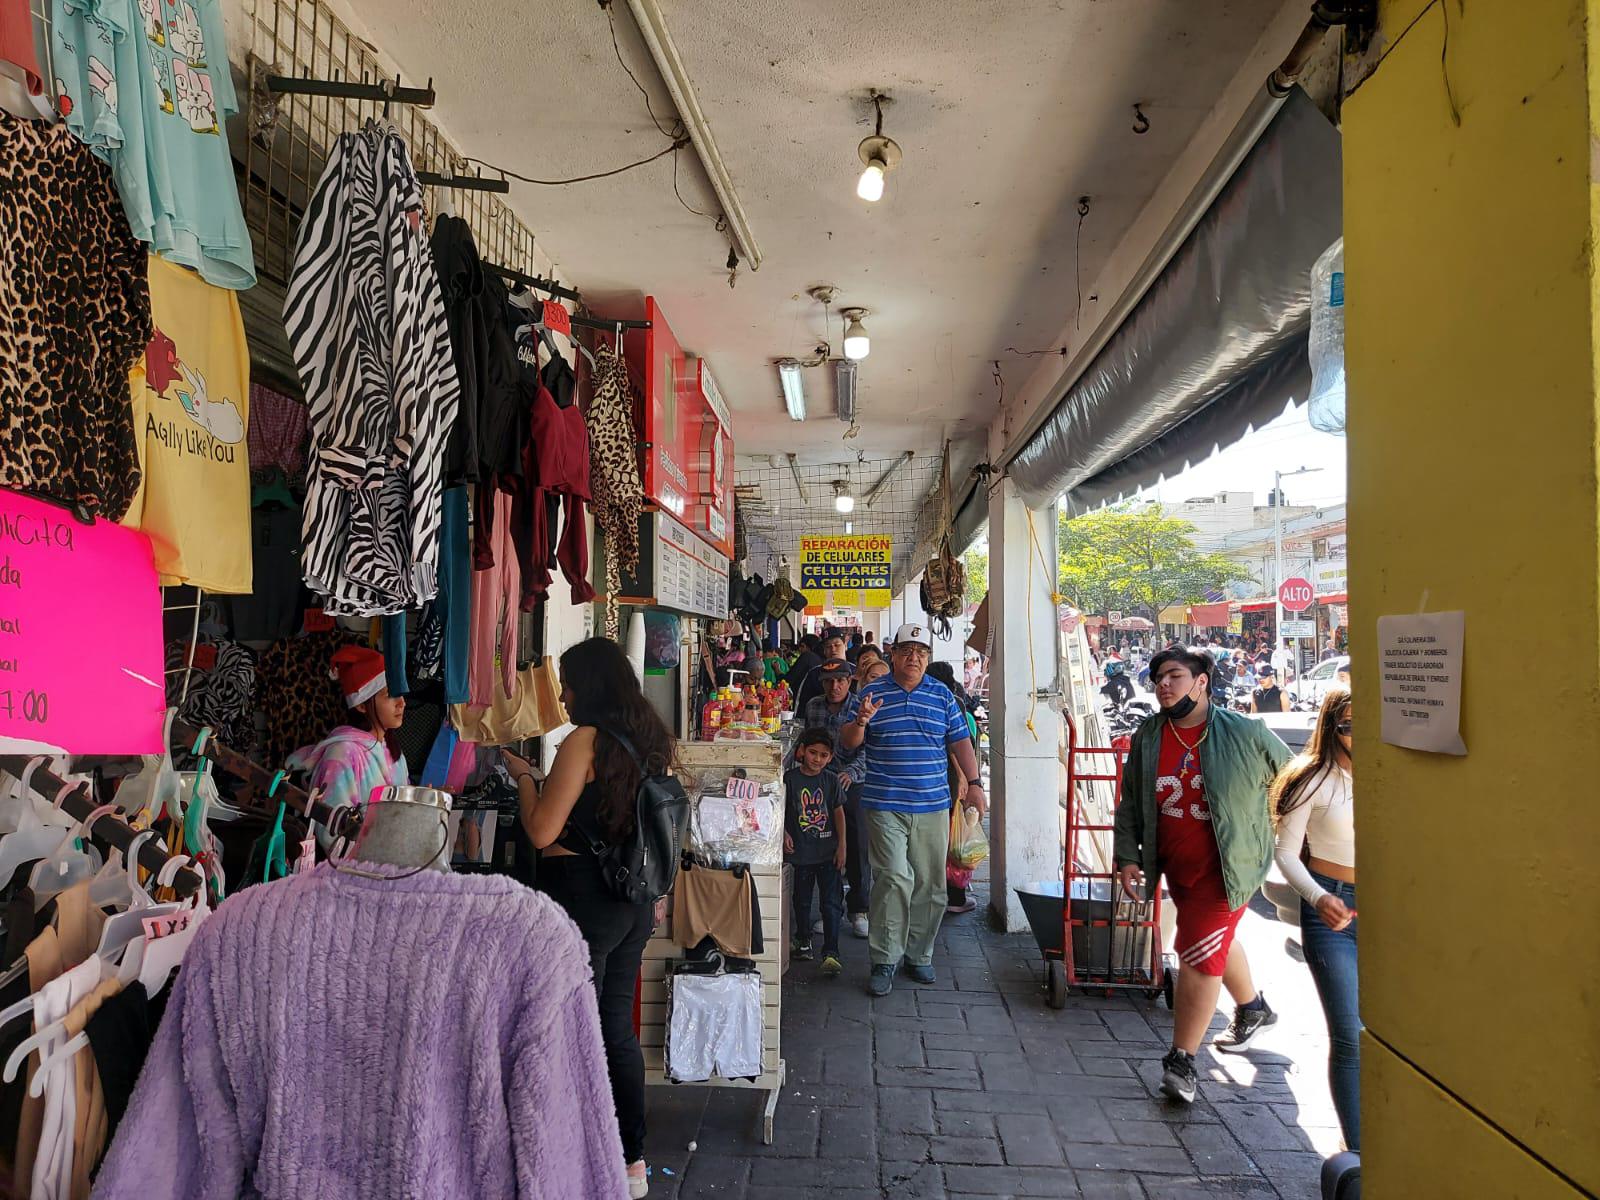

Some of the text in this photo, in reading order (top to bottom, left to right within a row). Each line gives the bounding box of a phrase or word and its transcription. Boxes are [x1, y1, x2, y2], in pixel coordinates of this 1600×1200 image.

[185, 428, 207, 458] Like
[206, 434, 235, 464] You
[802, 537, 890, 550] REPARACIÓN
[806, 551, 885, 562] DE CELULARES
[803, 566, 889, 576] CELULARES
[806, 576, 887, 587] A CRÉDITO
[1281, 586, 1311, 602] ALTO
